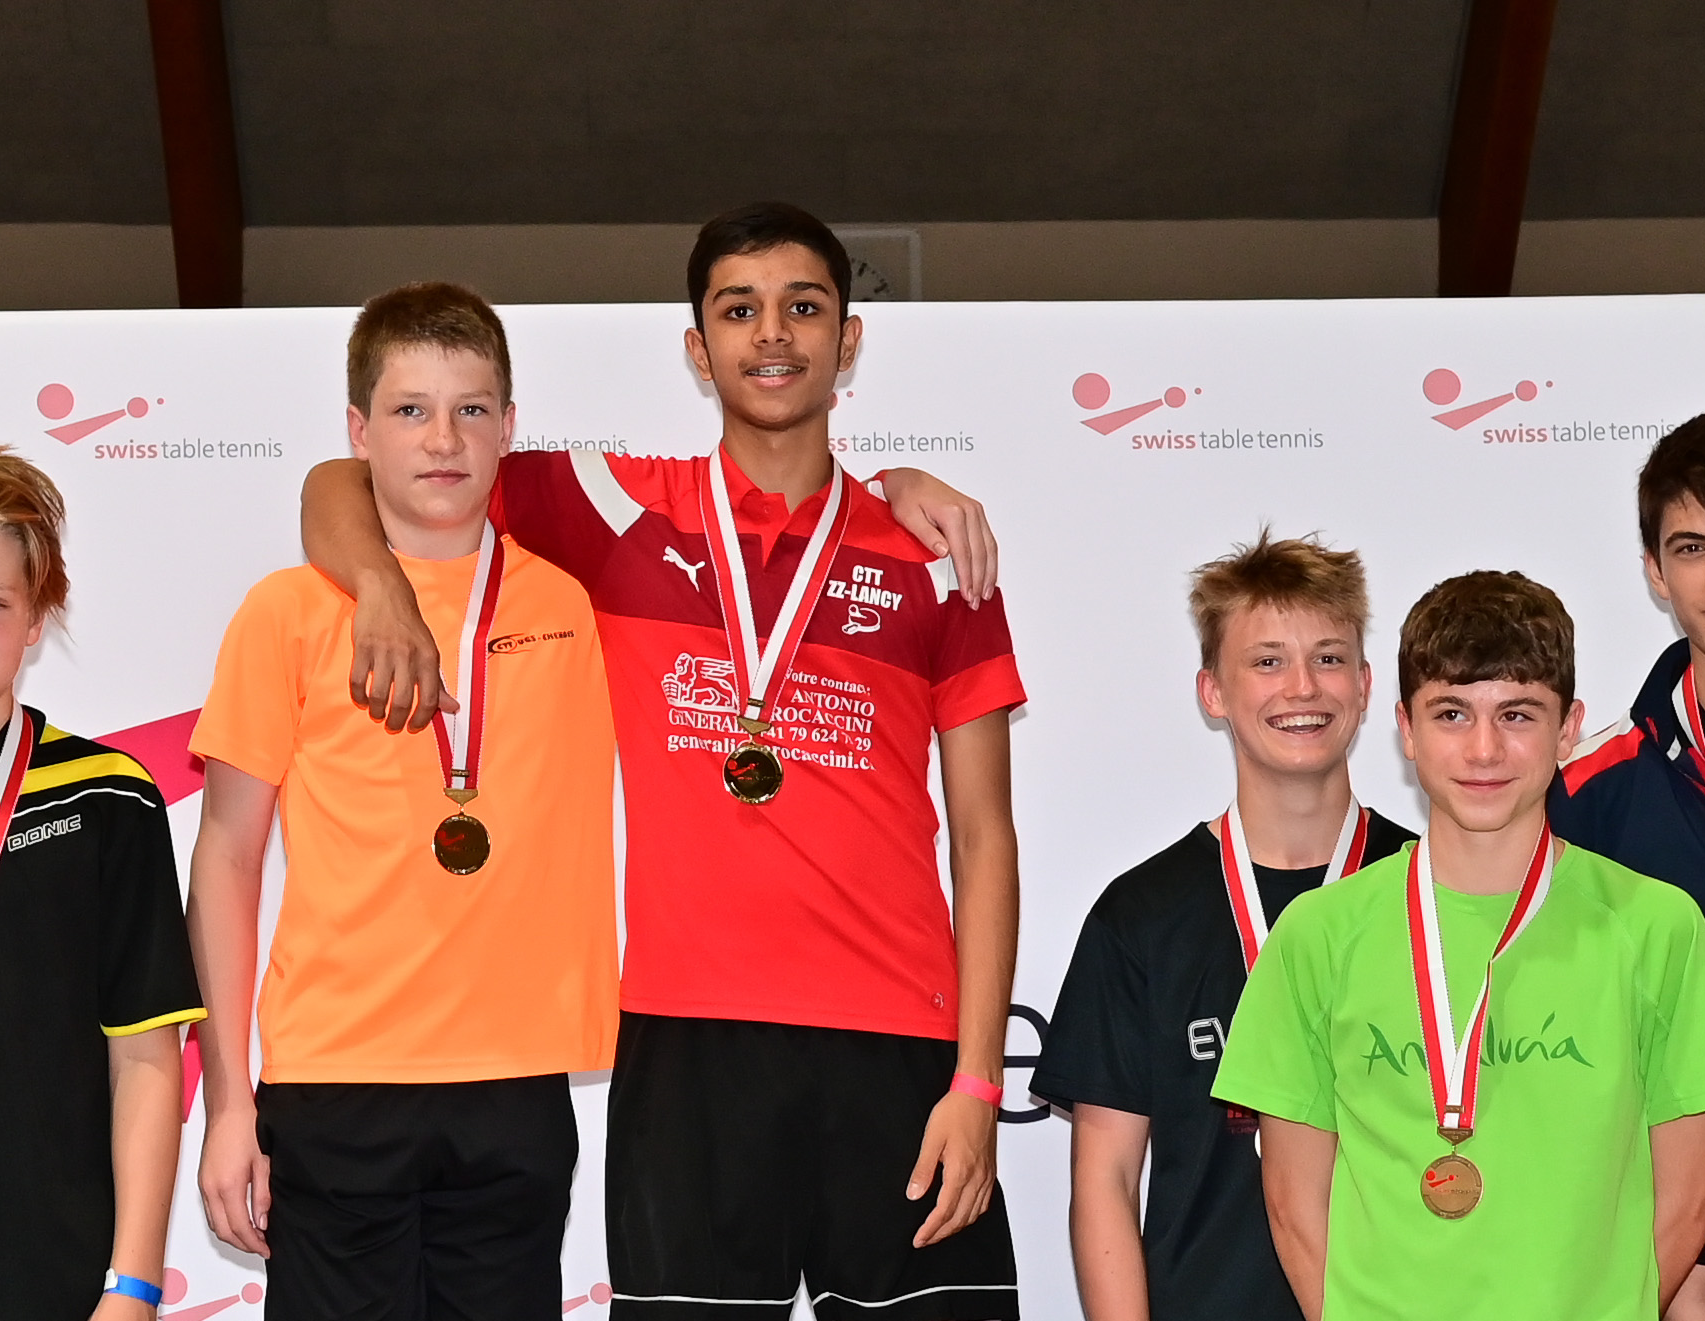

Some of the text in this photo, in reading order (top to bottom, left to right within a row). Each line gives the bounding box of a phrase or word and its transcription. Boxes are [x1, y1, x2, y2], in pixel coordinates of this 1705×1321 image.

[852, 565, 883, 586] CTT
[826, 580, 903, 611] ZZ-LANCY
[791, 688, 875, 717] ANTONIO
[772, 706, 872, 734] ROCACCINI
[789, 727, 807, 742] 79
[811, 728, 837, 743] 624
[855, 736, 872, 751] 29
[7, 814, 81, 851] DONIC
[1360, 1011, 1595, 1077] Anlucía
